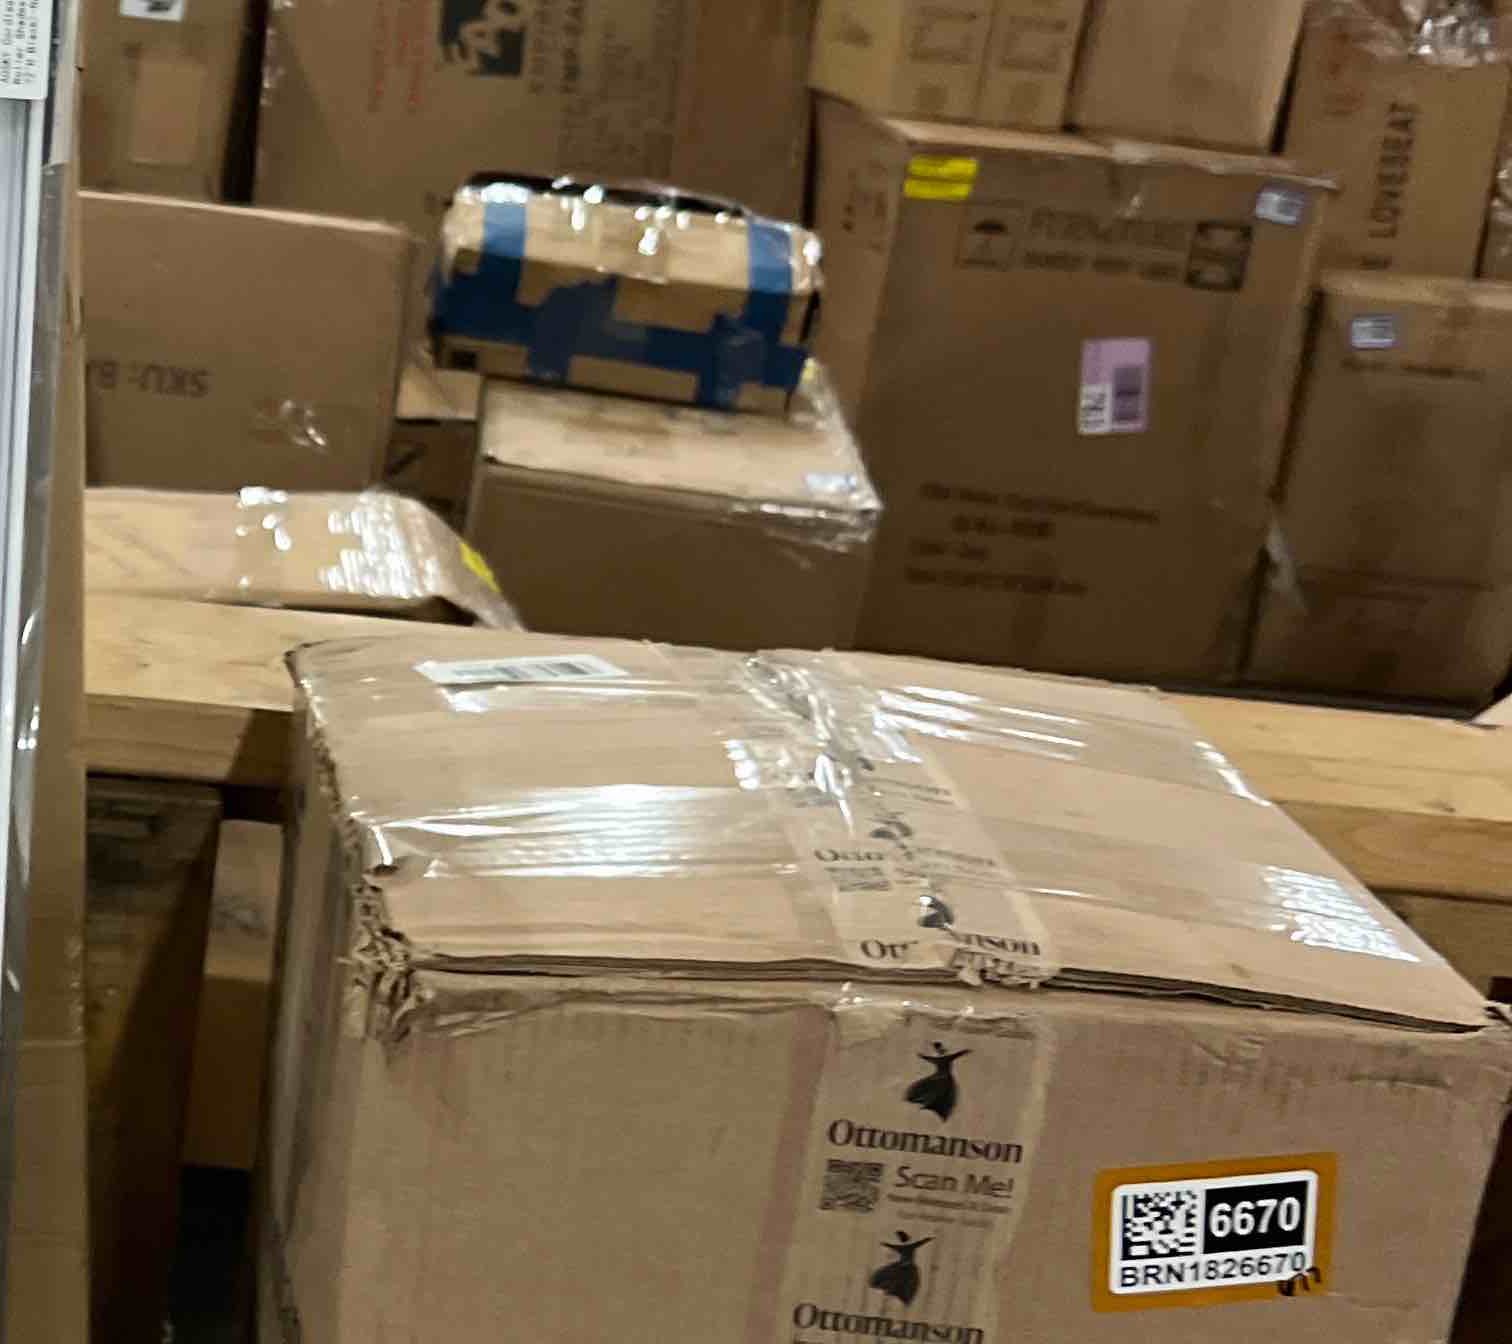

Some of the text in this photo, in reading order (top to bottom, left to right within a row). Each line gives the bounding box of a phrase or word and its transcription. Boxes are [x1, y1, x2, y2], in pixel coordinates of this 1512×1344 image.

[828, 1119, 1024, 1164] Ottomanson
[894, 1165, 1015, 1198] Scan Me!
[1208, 1196, 1302, 1238] 6670
[1120, 1251, 1307, 1288] BRN1826670
